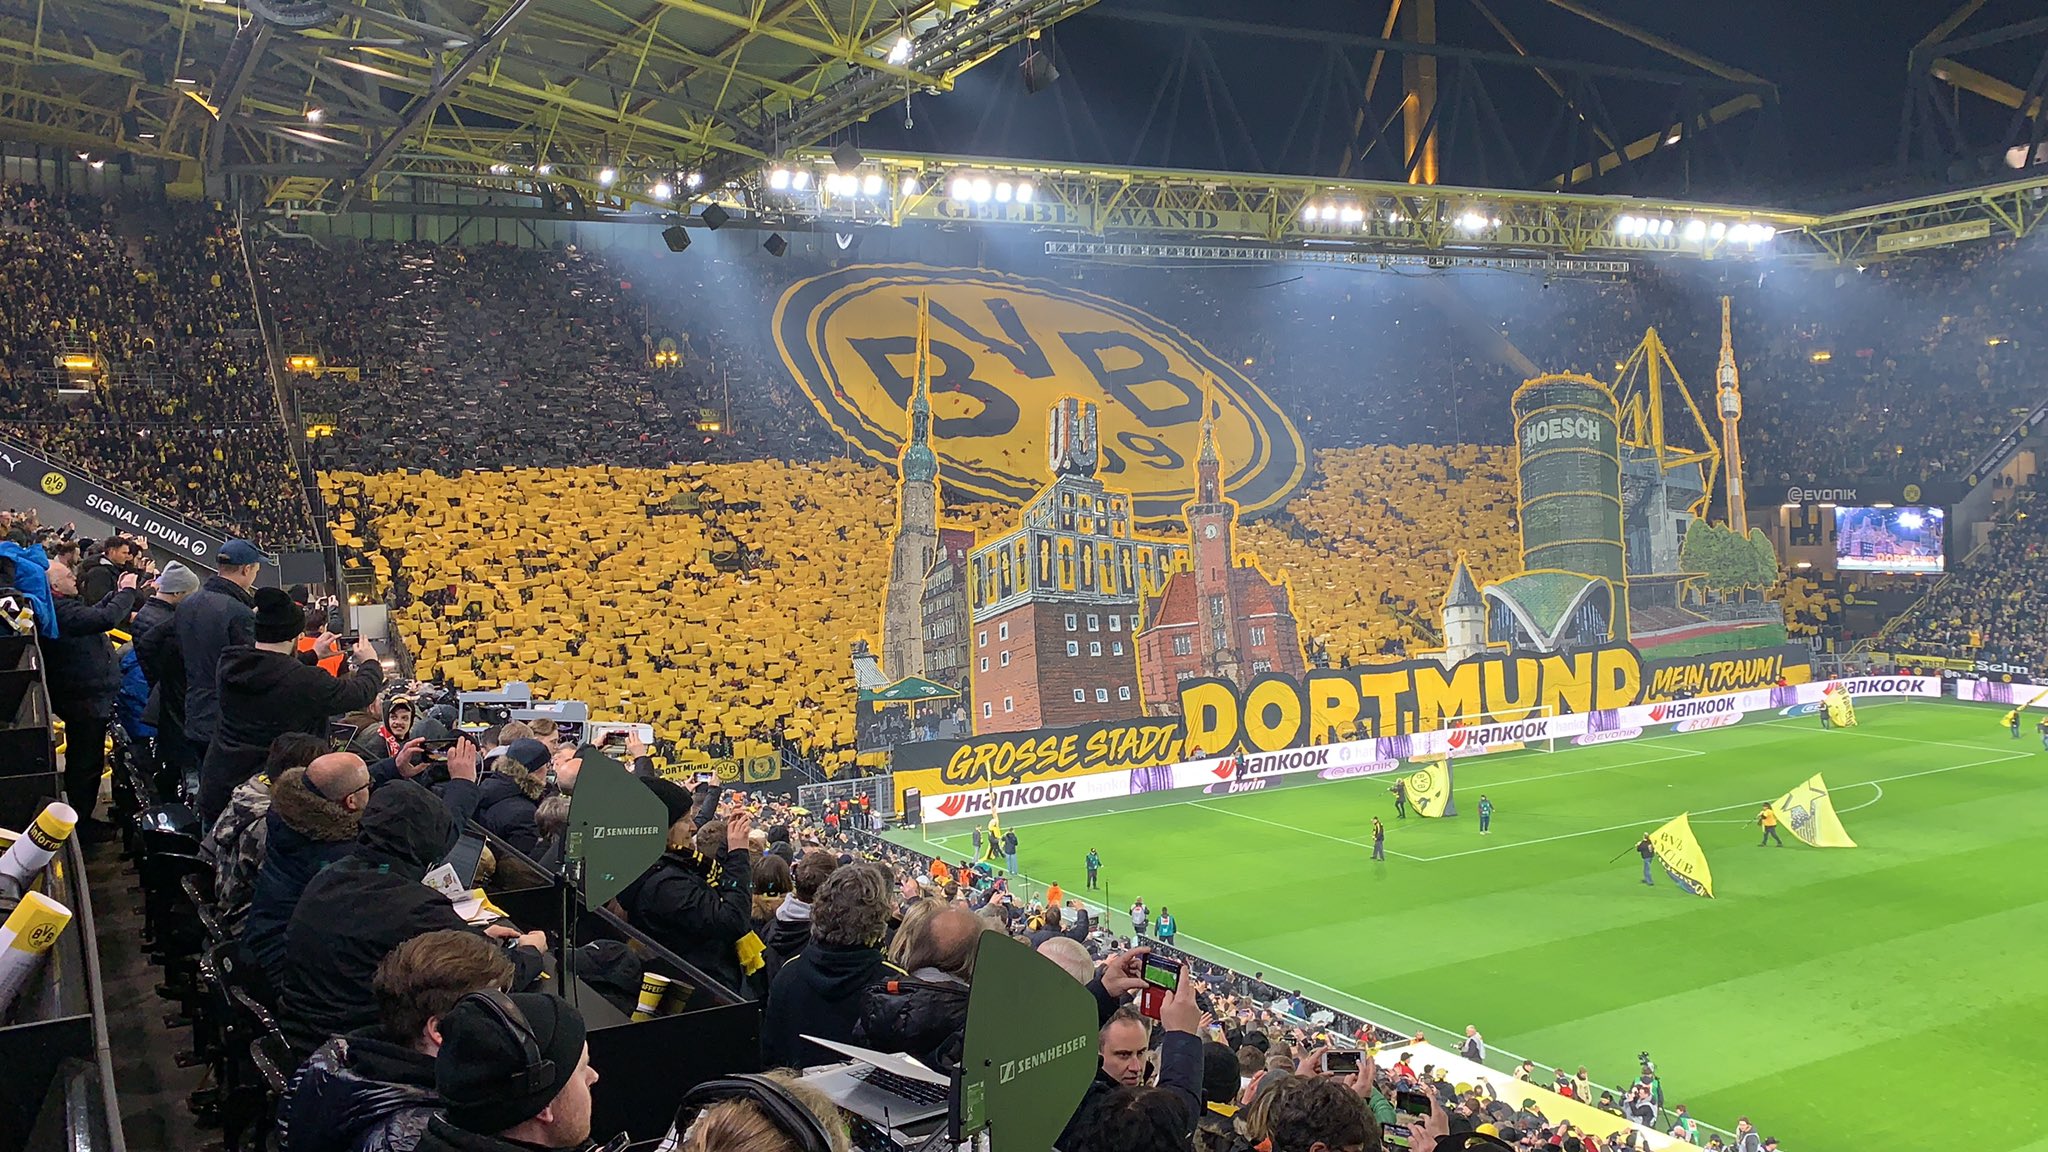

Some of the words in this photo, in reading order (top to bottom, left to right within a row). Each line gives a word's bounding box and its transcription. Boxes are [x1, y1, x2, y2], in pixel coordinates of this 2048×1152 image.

[847, 296, 1221, 440] BVB
[1526, 416, 1600, 447] HOESCH
[44, 475, 63, 490] BVB
[1803, 488, 1857, 501] EVONIK
[85, 493, 140, 528] SIGNAL
[143, 519, 189, 550] IDUNA
[1976, 660, 2028, 674] Selm
[945, 734, 1079, 780] GROSSE
[1084, 723, 1178, 763] STADT
[1182, 647, 1641, 755] DORTMUND
[1652, 662, 1706, 694] MEIN
[1709, 654, 1782, 688] TRAUM!
[1688, 713, 1732, 730] ROWE
[1597, 729, 1637, 741] EVONIK
[717, 763, 737, 774] BVB
[1345, 760, 1394, 775] EVONIK
[1228, 777, 1266, 794] bwin
[606, 826, 659, 836] SENNHEISER
[32, 923, 54, 943] BVB
[1018, 1035, 1087, 1073] SENNHEISER
